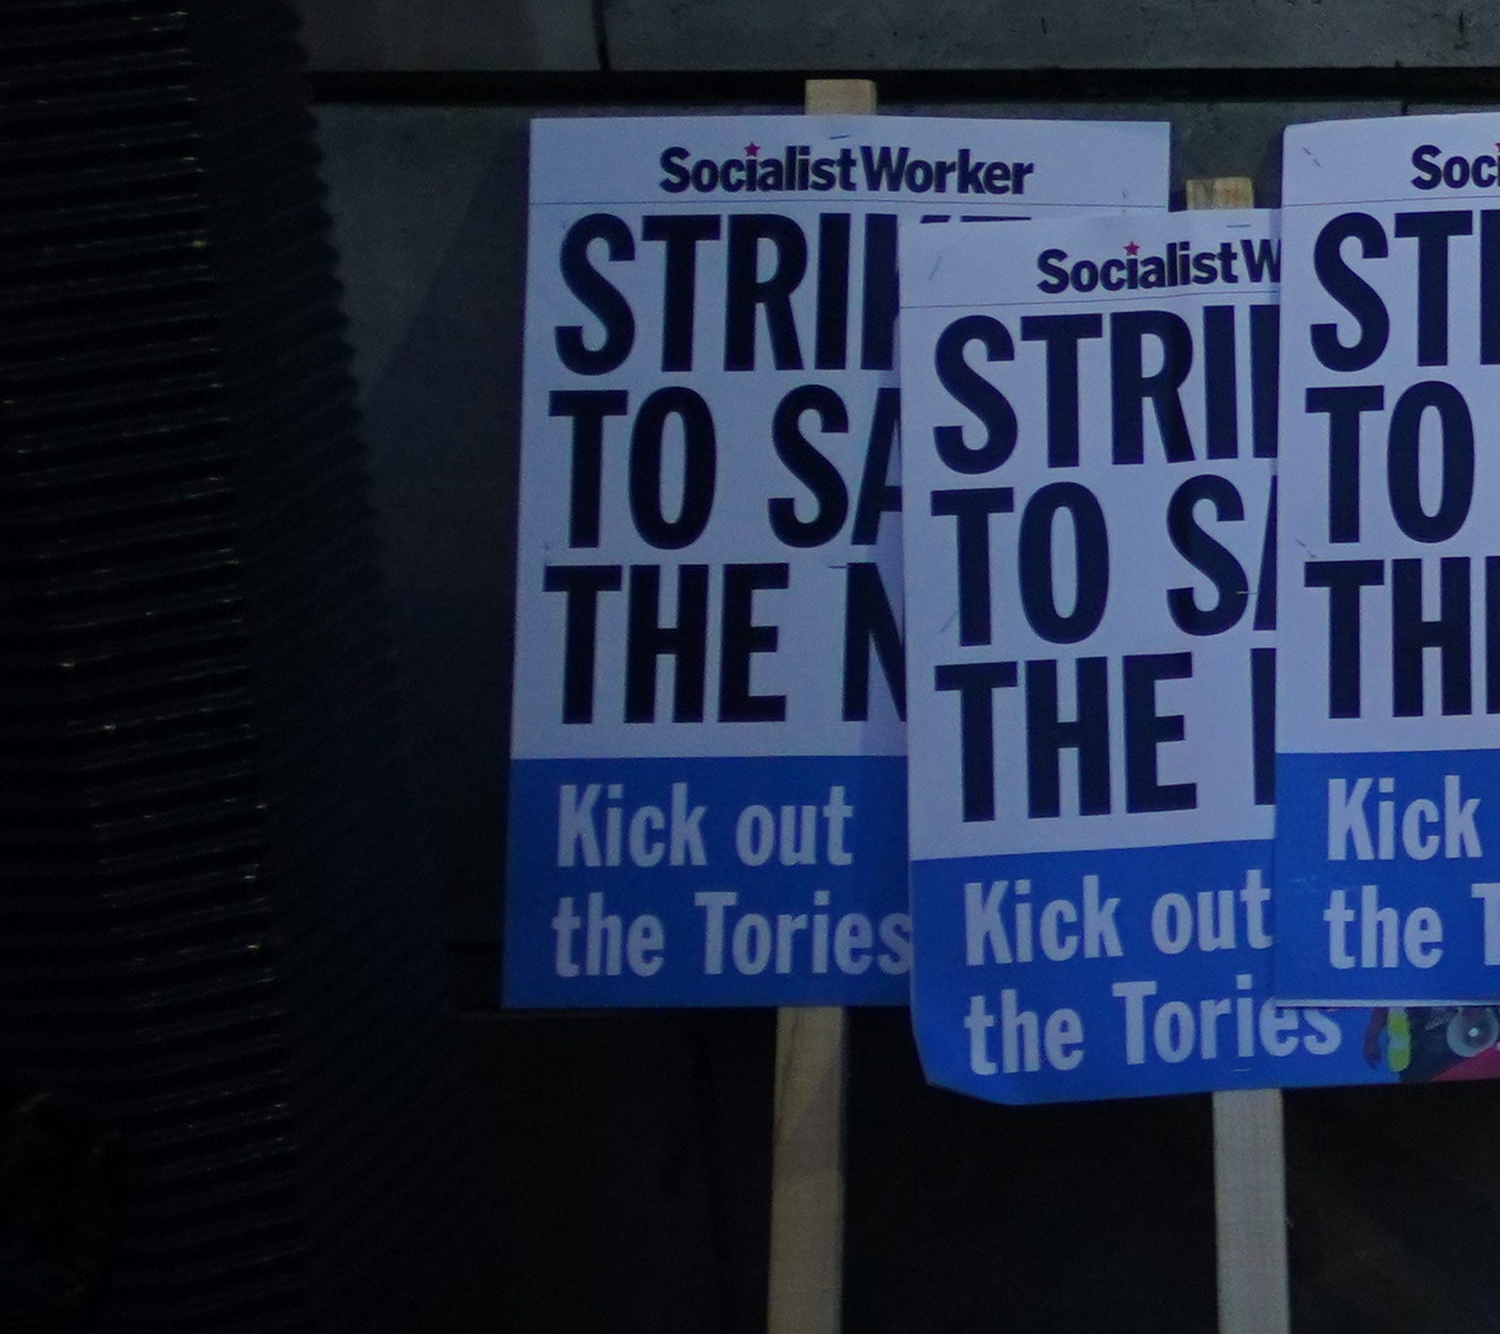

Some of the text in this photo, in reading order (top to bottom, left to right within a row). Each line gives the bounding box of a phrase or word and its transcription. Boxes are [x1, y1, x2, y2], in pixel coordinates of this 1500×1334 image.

[659, 142, 1033, 195] Socialist Worker
[549, 386, 717, 550] TO
[1305, 380, 1475, 544] TO
[930, 481, 1110, 646] TO
[543, 562, 789, 724] THE
[934, 652, 1197, 823] THE
[558, 783, 853, 868] Kick out
[1327, 775, 1483, 861] Kick
[552, 893, 664, 977] the
[964, 869, 1273, 966] Kick out
[1323, 886, 1442, 969] the
[964, 989, 1084, 1076] the
